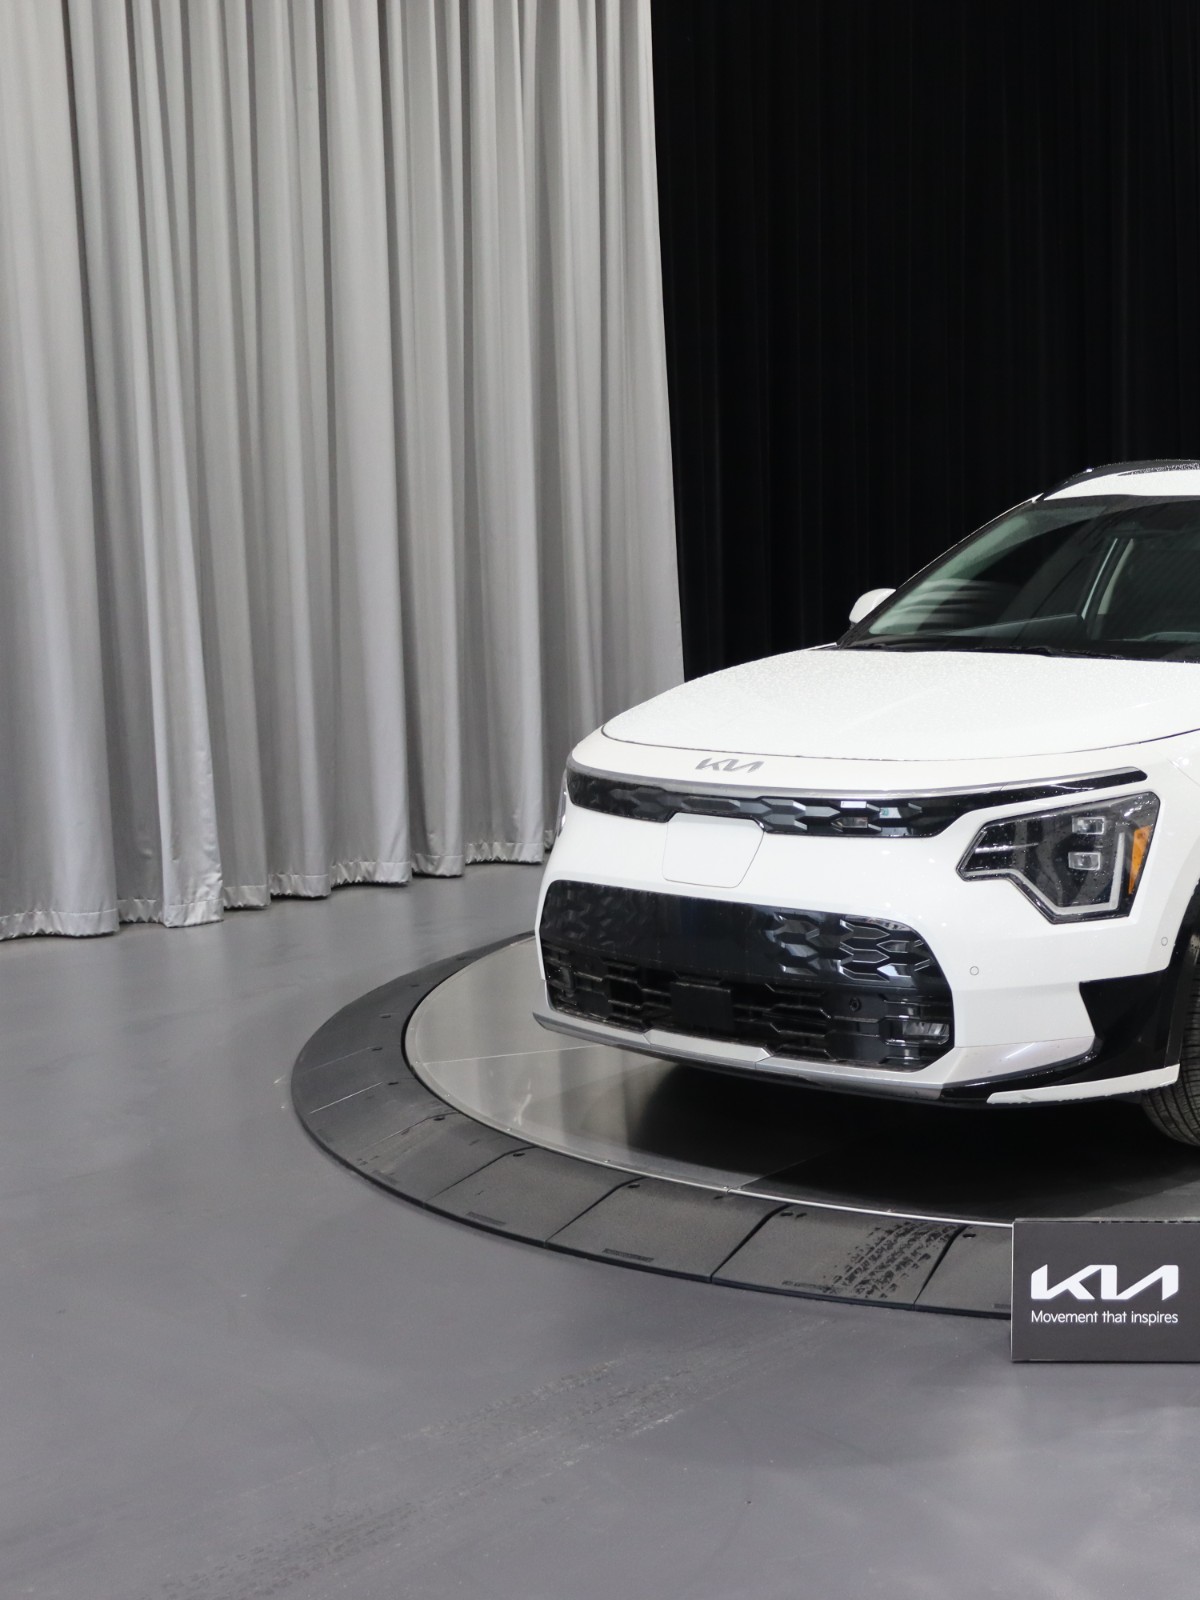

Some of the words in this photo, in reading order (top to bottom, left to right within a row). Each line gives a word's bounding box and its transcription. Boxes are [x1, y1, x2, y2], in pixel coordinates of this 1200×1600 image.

[694, 757, 765, 774] KIA
[1030, 1263, 1180, 1301] KIA
[1030, 1309, 1099, 1324] Movement
[1101, 1309, 1128, 1324] that
[1130, 1310, 1179, 1327] inspires
